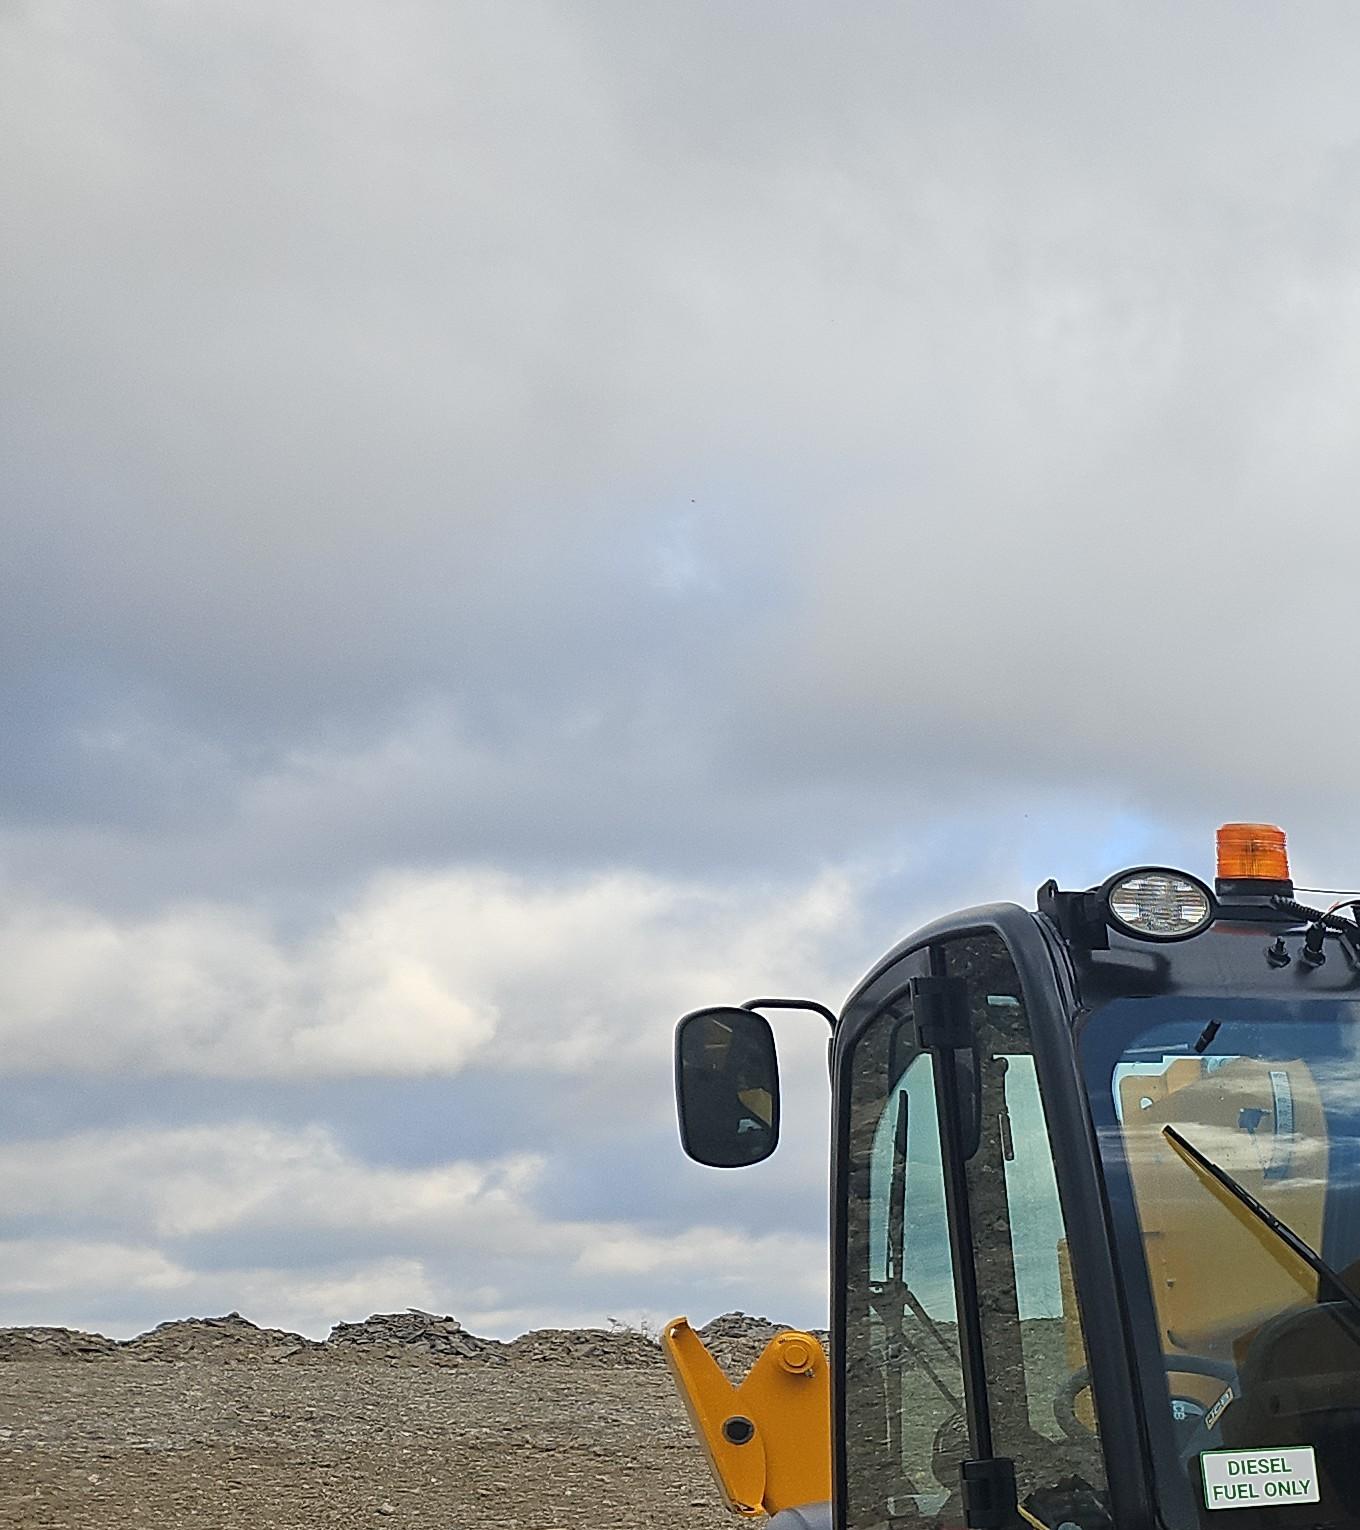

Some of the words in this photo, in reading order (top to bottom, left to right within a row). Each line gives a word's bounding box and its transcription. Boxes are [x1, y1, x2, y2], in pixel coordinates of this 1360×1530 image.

[1228, 1457, 1292, 1476] DIESEL
[1213, 1483, 1259, 1501] FUEL
[1264, 1479, 1311, 1498] ONLY
